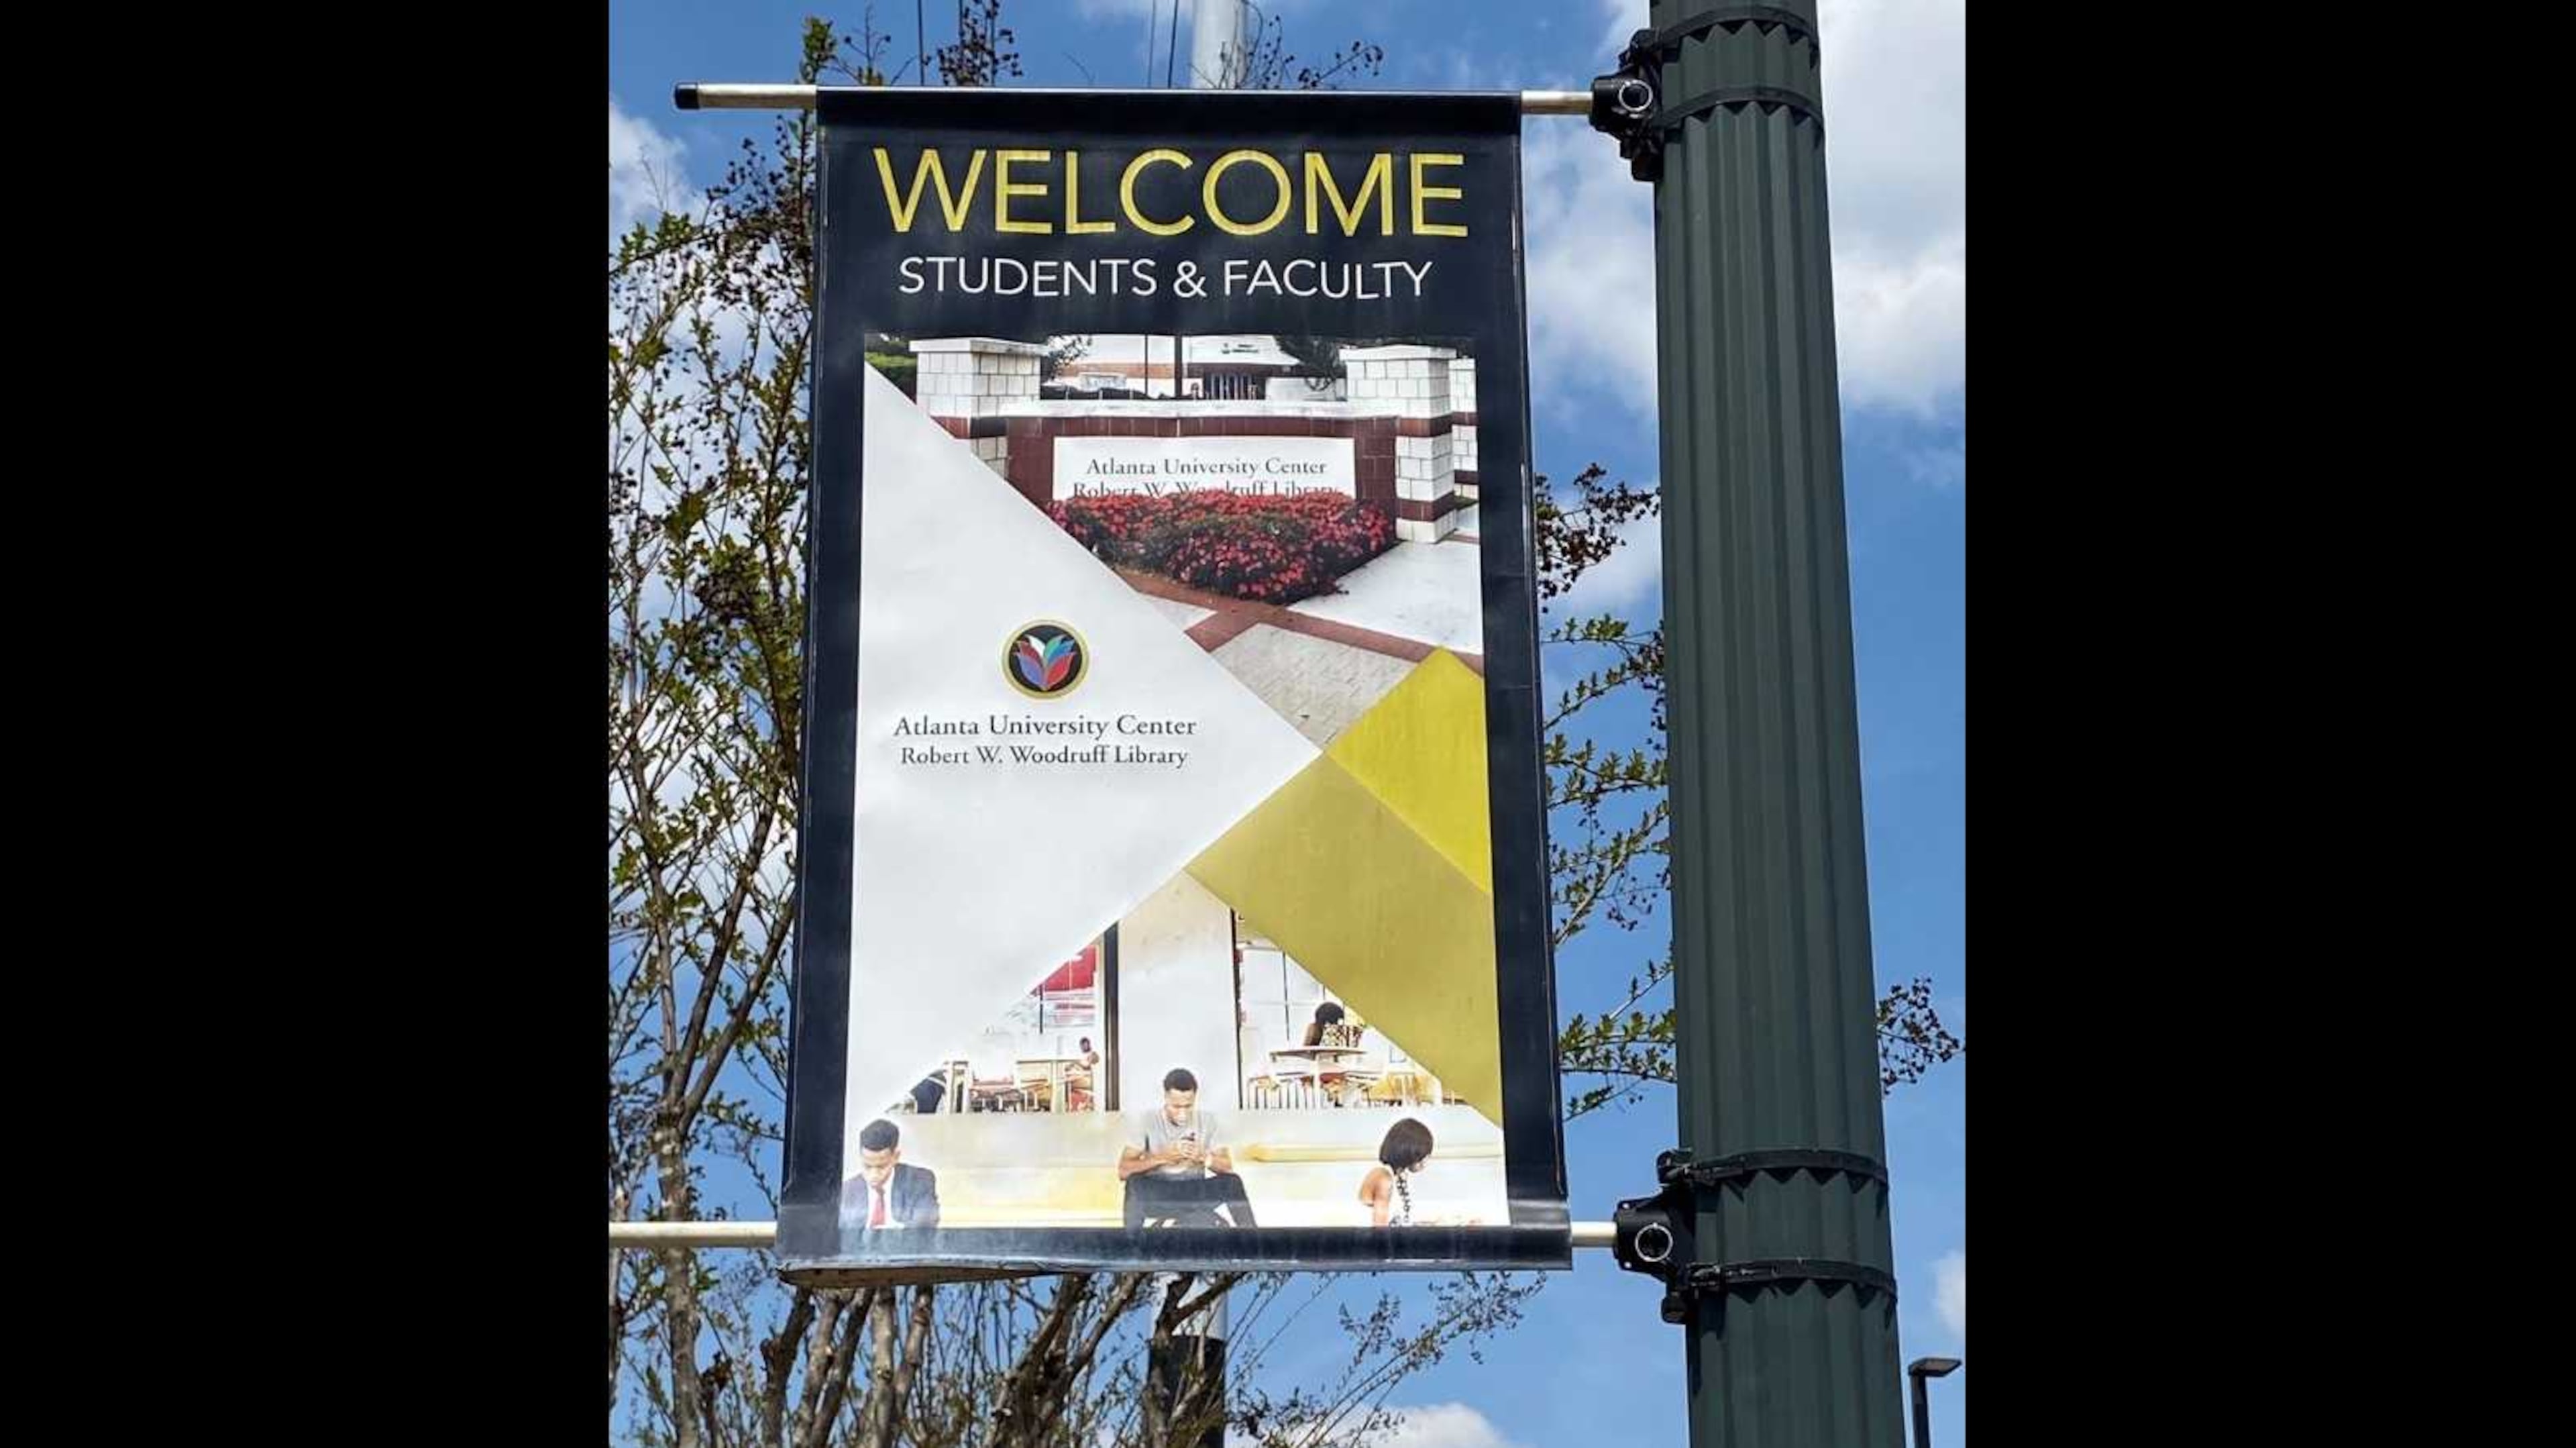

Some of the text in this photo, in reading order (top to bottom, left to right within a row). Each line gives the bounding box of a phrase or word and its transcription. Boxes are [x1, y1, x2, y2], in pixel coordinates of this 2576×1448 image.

[873, 148, 1468, 237] WELCOME
[898, 256, 1433, 300] STUDENTS & FACULTY
[1086, 458, 1327, 478] Atlanta University Center
[894, 714, 1197, 741] Atlanta University Center
[901, 744, 1188, 769] Robert W. Woodruff Library
